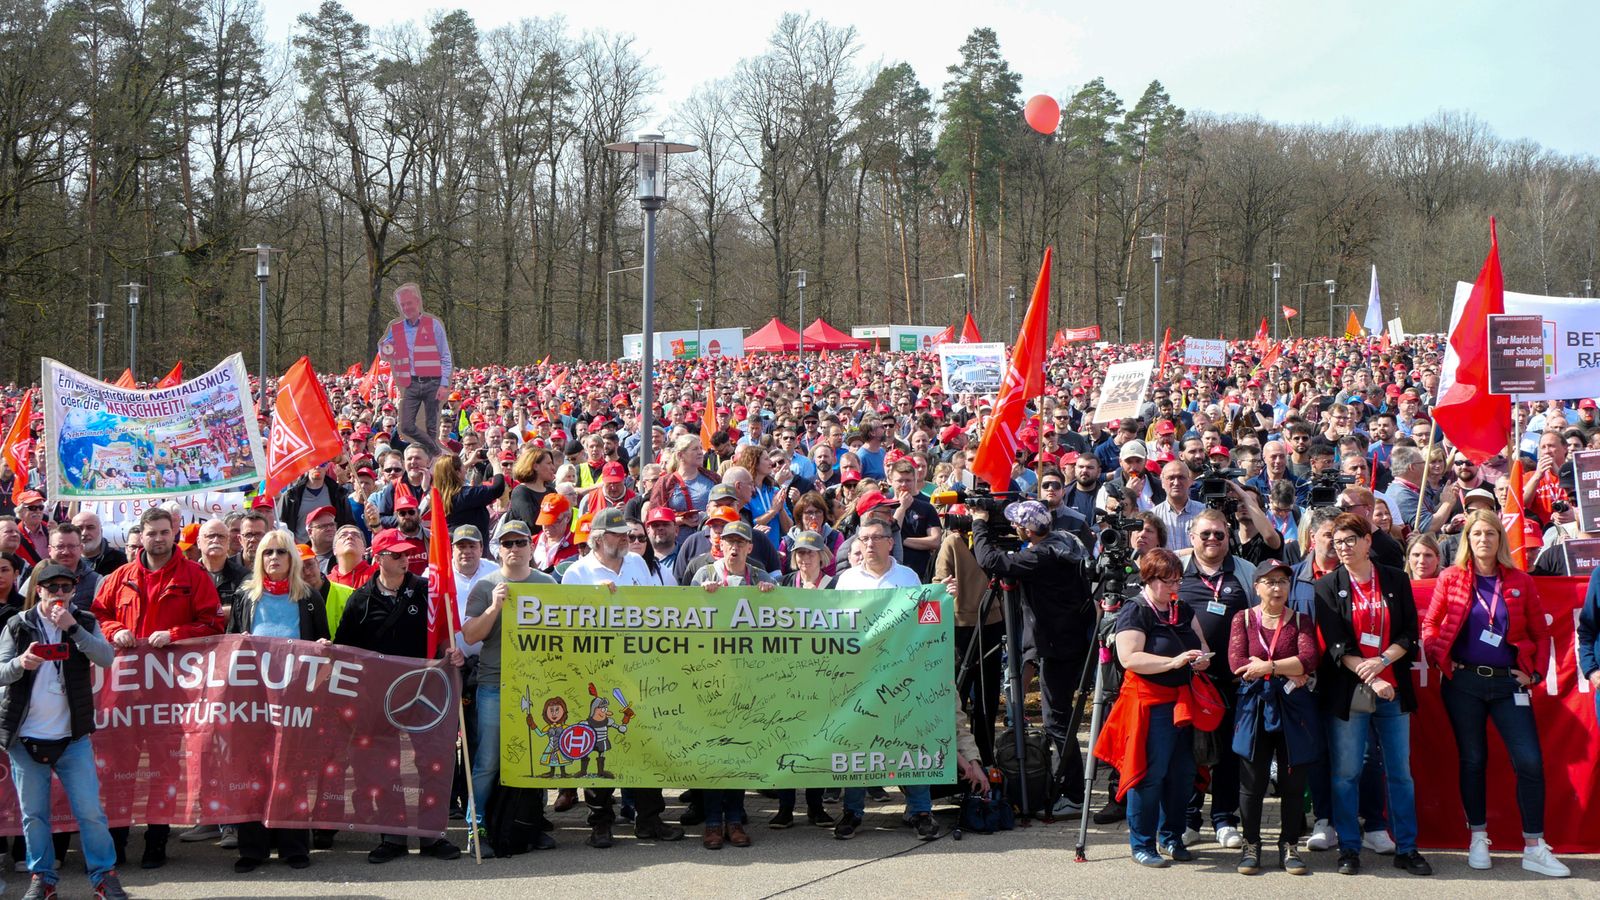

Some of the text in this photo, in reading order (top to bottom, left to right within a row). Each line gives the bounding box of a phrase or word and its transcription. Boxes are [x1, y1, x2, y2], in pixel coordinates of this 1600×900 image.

[1496, 335, 1542, 345] Der Markt hat
[1503, 346, 1543, 356] nur Scheiße
[1515, 359, 1524, 367] im
[60, 394, 186, 418] oder die MENSCHHEIT!
[518, 634, 563, 652] WIR
[573, 635, 614, 654] MIT
[624, 635, 688, 655] EUCH
[713, 636, 757, 655] IHR
[762, 636, 804, 655] MIT
[810, 636, 862, 655] UNS
[639, 676, 678, 701] Heiko
[94, 698, 313, 729] UNTERTÜRKHEIM
[114, 768, 161, 780] Hedelfingen
[653, 772, 698, 785] Julian
[833, 774, 848, 782] WIR
[849, 773, 862, 781] MIT
[864, 773, 886, 781] EUCH
[912, 771, 925, 779] MIT
[927, 770, 944, 778] UNS
[229, 782, 250, 791] Brühl
